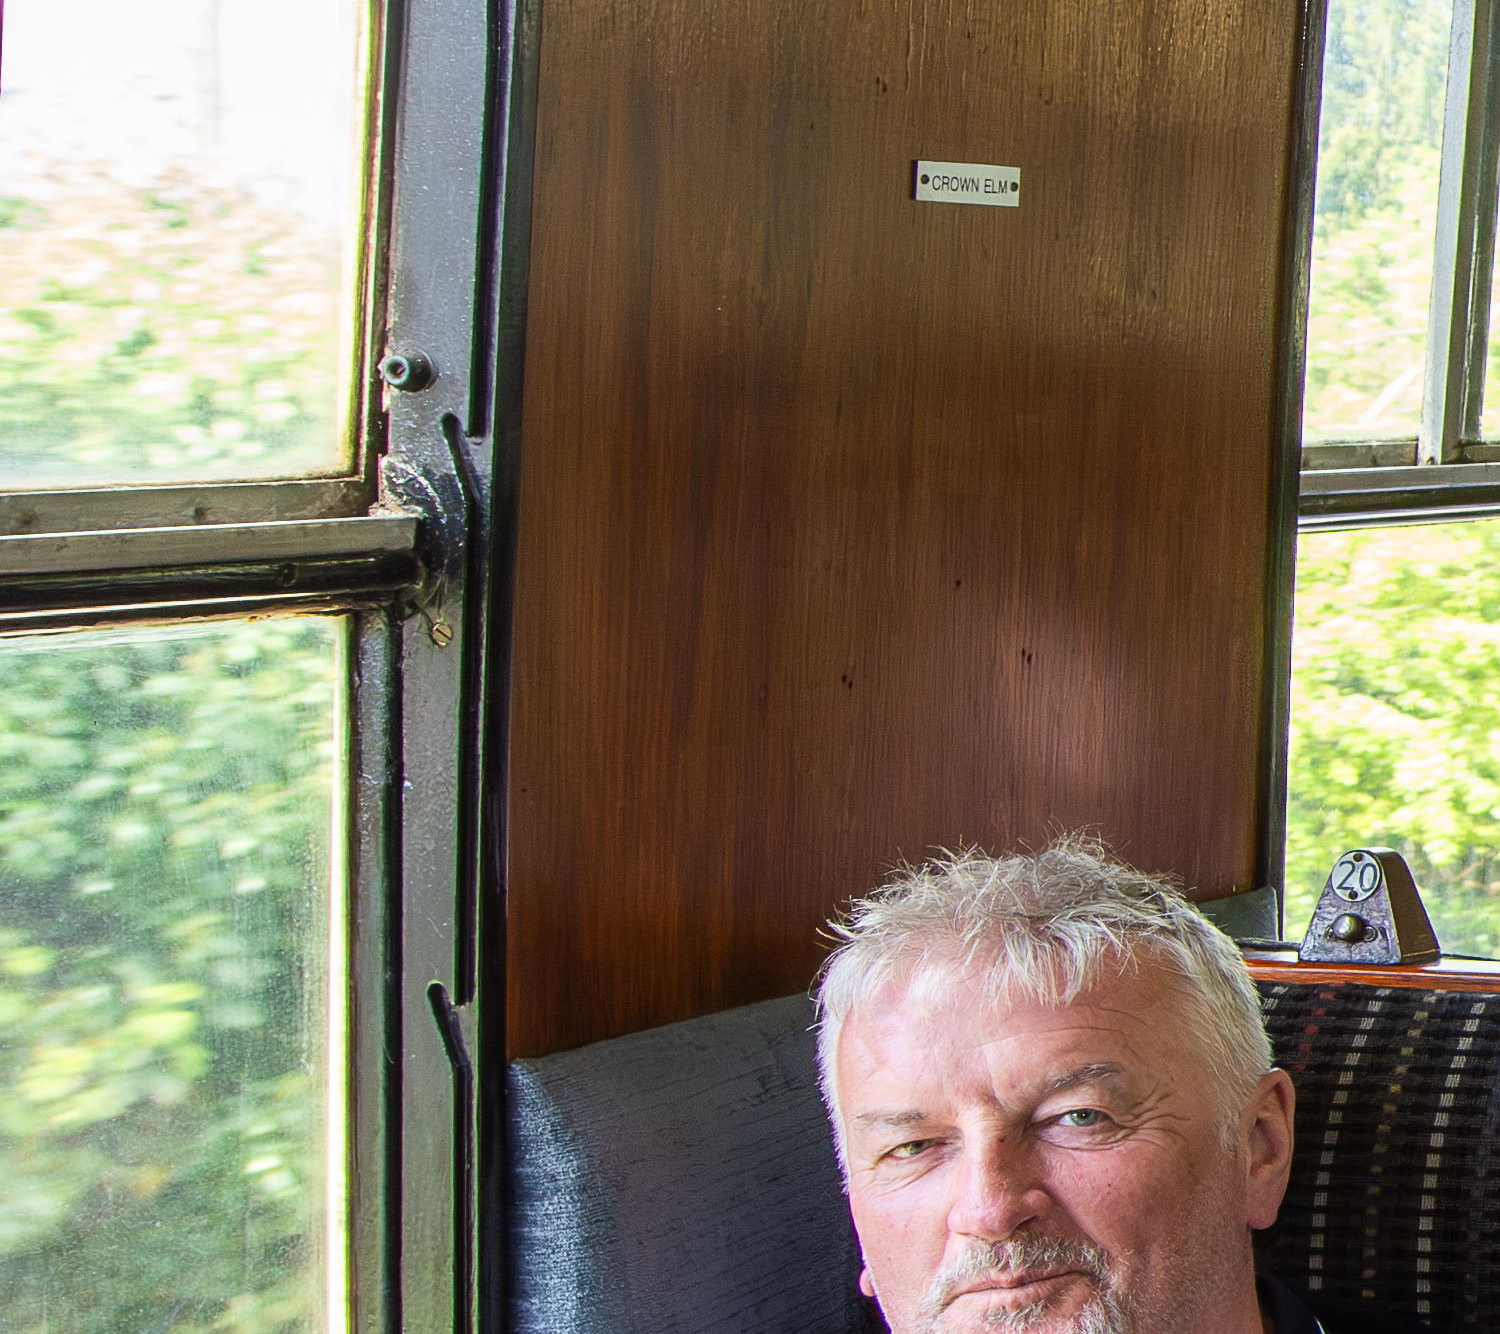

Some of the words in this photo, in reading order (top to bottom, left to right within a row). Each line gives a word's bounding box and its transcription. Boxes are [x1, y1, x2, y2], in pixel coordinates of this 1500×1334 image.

[932, 175, 980, 192] CROWN
[984, 178, 1008, 194] ELM
[1336, 860, 1379, 893] 20
